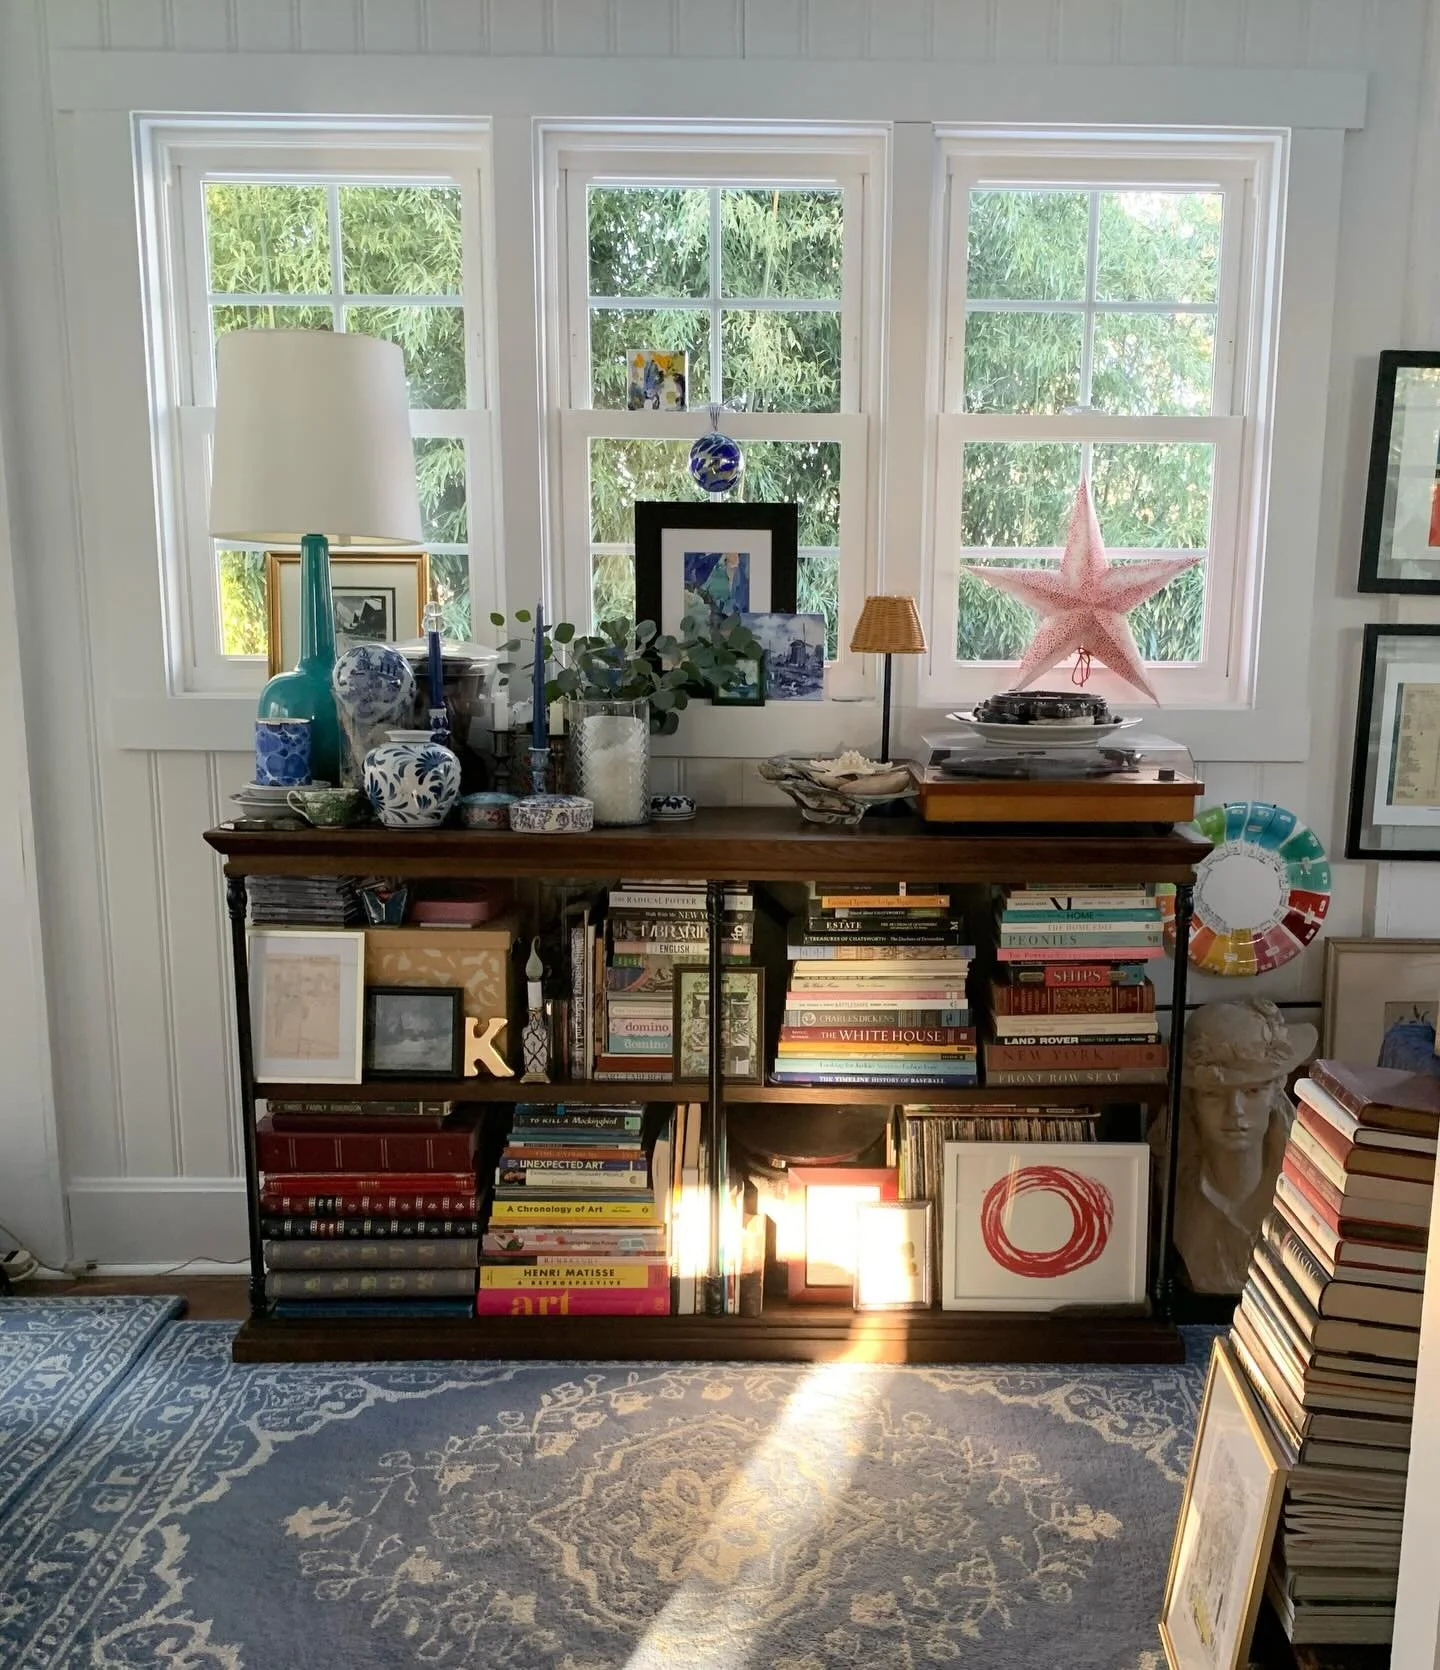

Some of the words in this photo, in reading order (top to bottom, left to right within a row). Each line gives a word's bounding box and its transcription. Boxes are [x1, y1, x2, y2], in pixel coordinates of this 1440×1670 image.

[665, 897, 697, 905] POTTER
[678, 911, 698, 919] NEW
[1066, 911, 1094, 920] HOME
[826, 921, 863, 929] ESTATE
[1009, 935, 1078, 945] PEONIES
[659, 945, 690, 954] ENGLISH
[1053, 969, 1101, 982] SHIPS
[819, 1014, 859, 1023] CHARLES
[859, 1014, 895, 1023] DICKENS
[625, 1022, 669, 1032] domino
[821, 1031, 837, 1039] THE
[839, 1030, 889, 1042] WHITE
[892, 1030, 942, 1042] HOUSE
[1004, 1037, 1036, 1045] LAND
[1039, 1036, 1079, 1044] ROVER
[464, 1017, 515, 1077] K
[624, 1038, 668, 1049] domino
[1003, 1050, 1041, 1062] NEW
[1052, 1049, 1104, 1061] YORK
[999, 1073, 1042, 1084] FRONT
[1049, 1073, 1080, 1083] ROW
[1087, 1072, 1121, 1082] SEAT
[571, 1116, 618, 1127] Mockingbird
[519, 1159, 584, 1169] UNEXPECTED
[585, 1160, 605, 1170] ART
[517, 1205, 572, 1214] Chronology
[575, 1205, 585, 1213] of
[587, 1205, 604, 1213] Art
[523, 1269, 560, 1277] HENRI
[566, 1269, 616, 1277] MATISSE
[511, 1290, 573, 1315] art
